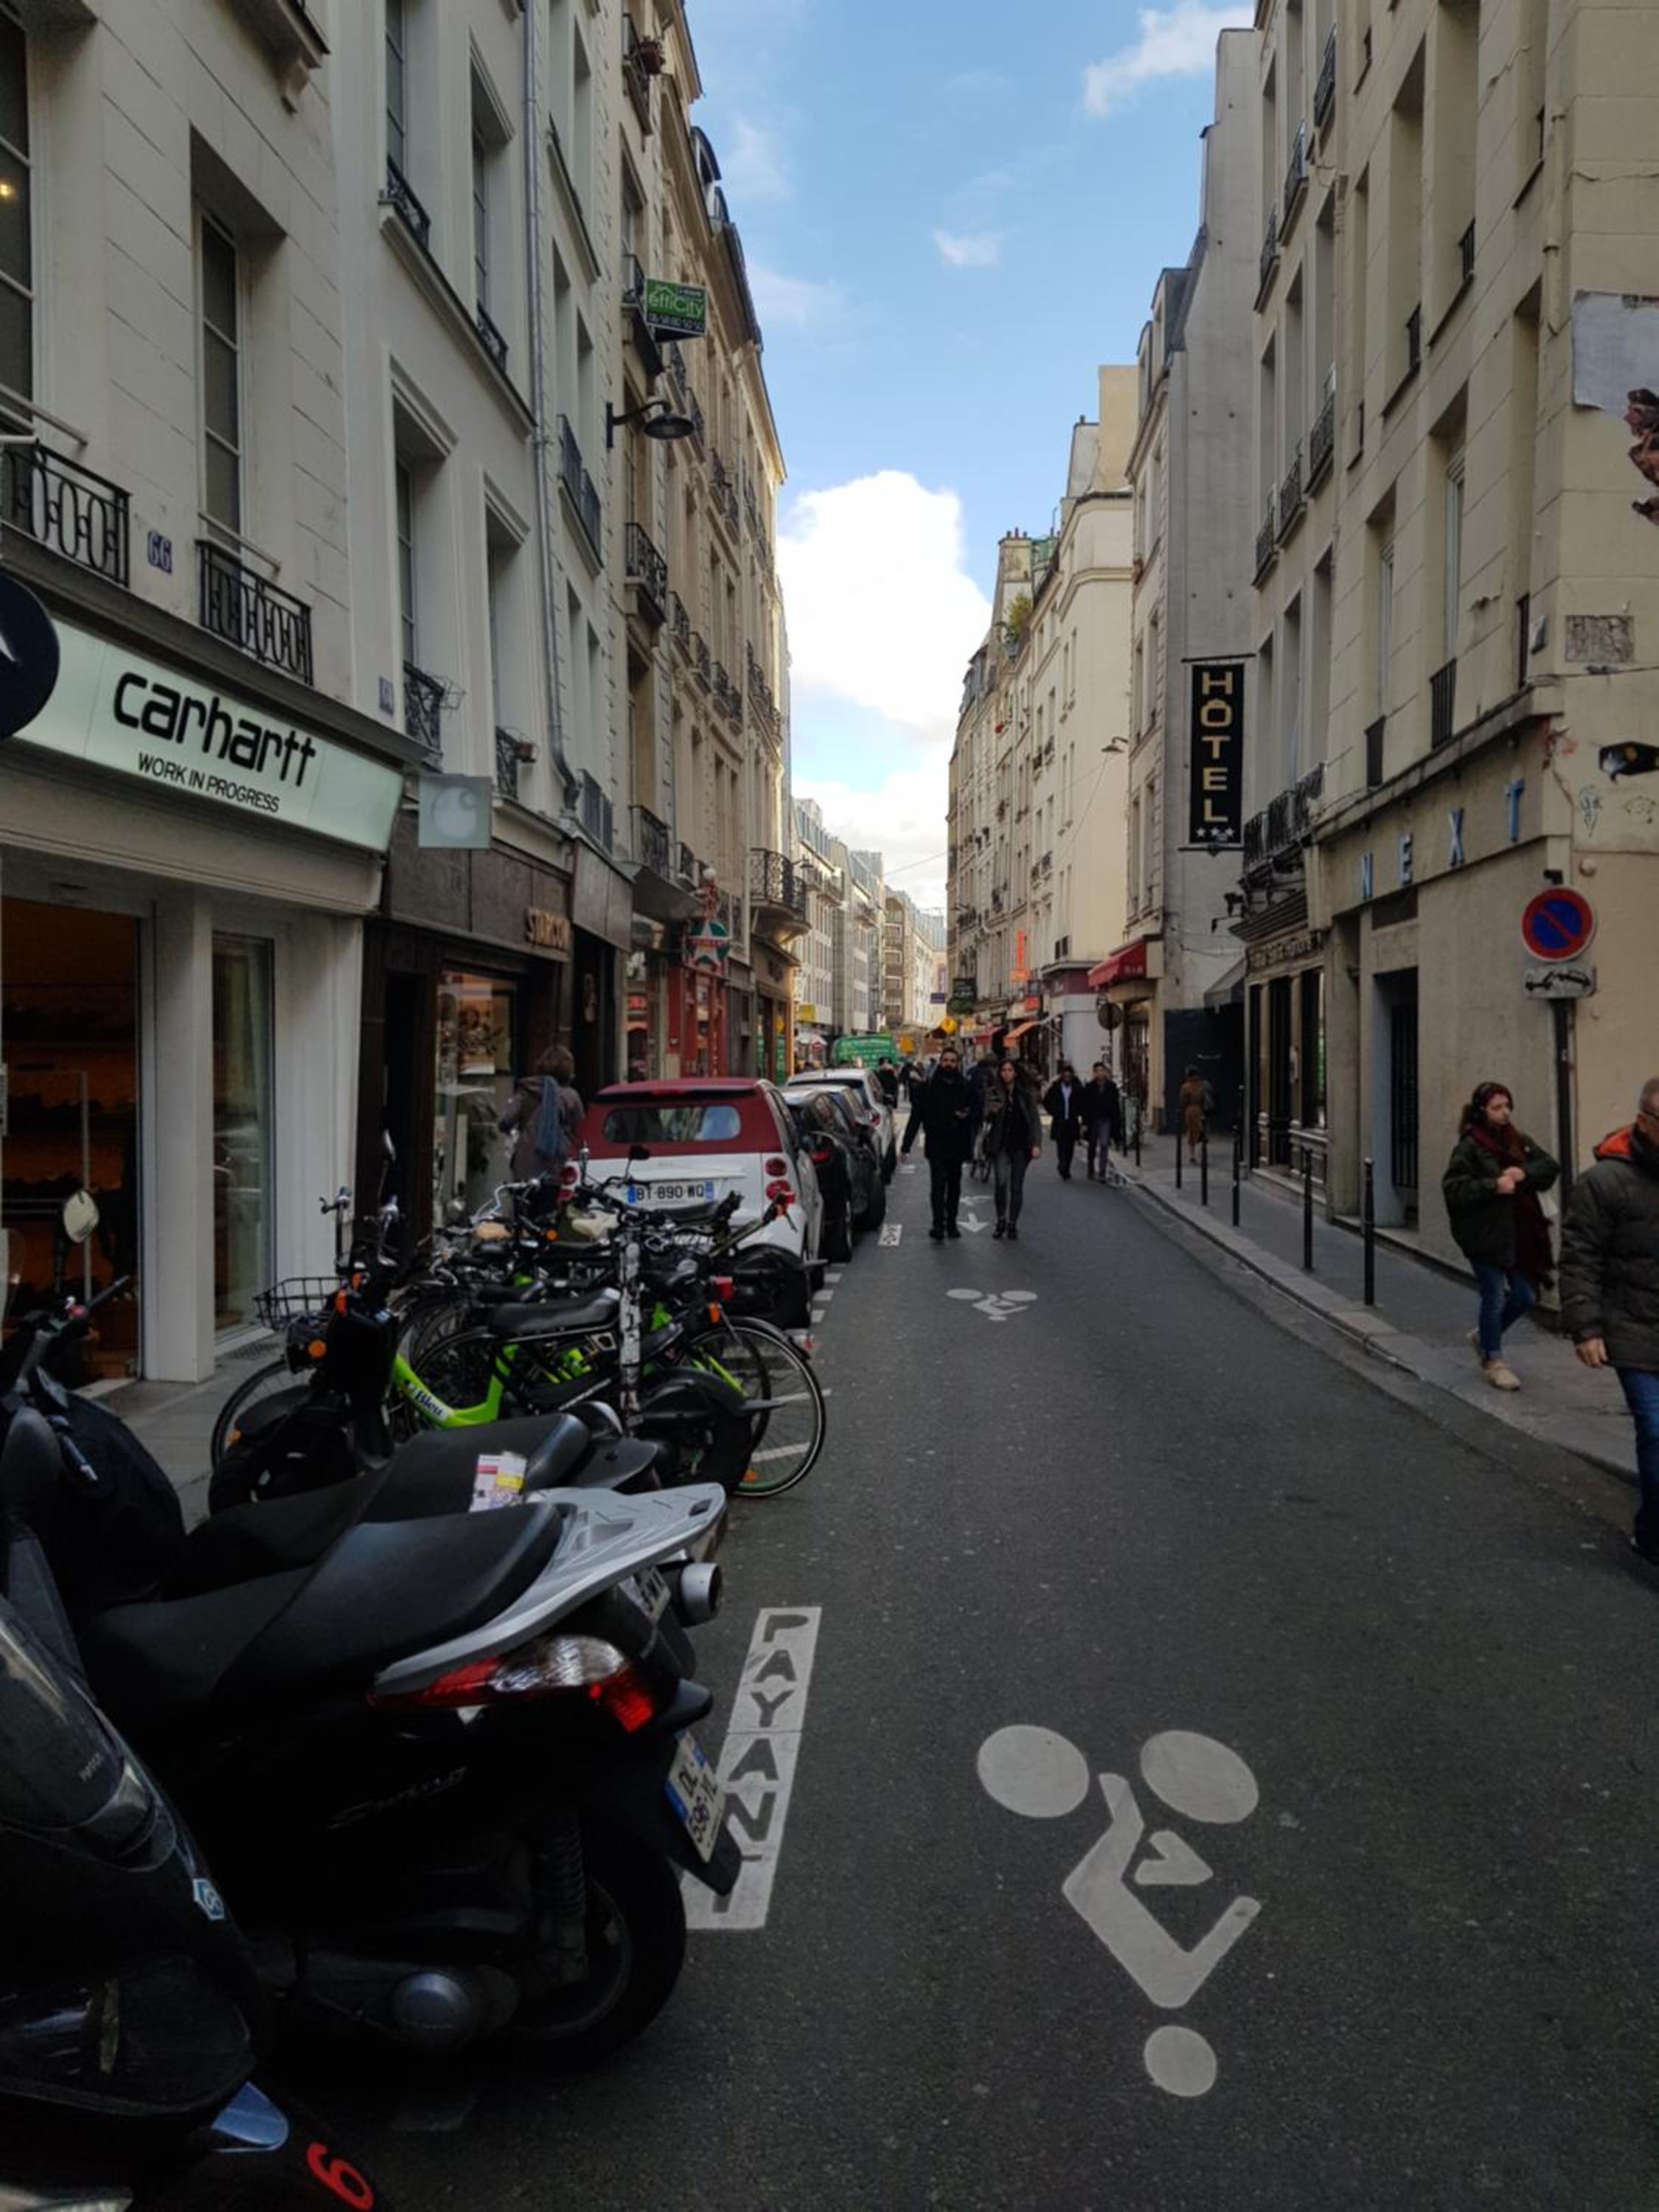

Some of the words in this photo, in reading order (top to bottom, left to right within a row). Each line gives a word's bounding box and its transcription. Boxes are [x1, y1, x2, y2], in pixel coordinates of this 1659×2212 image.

[114, 672, 316, 787] carhartt
[139, 751, 187, 785] WORK
[188, 768, 206, 790] IN
[206, 775, 280, 813] PROGRESS
[1360, 778, 1525, 900] NEXT
